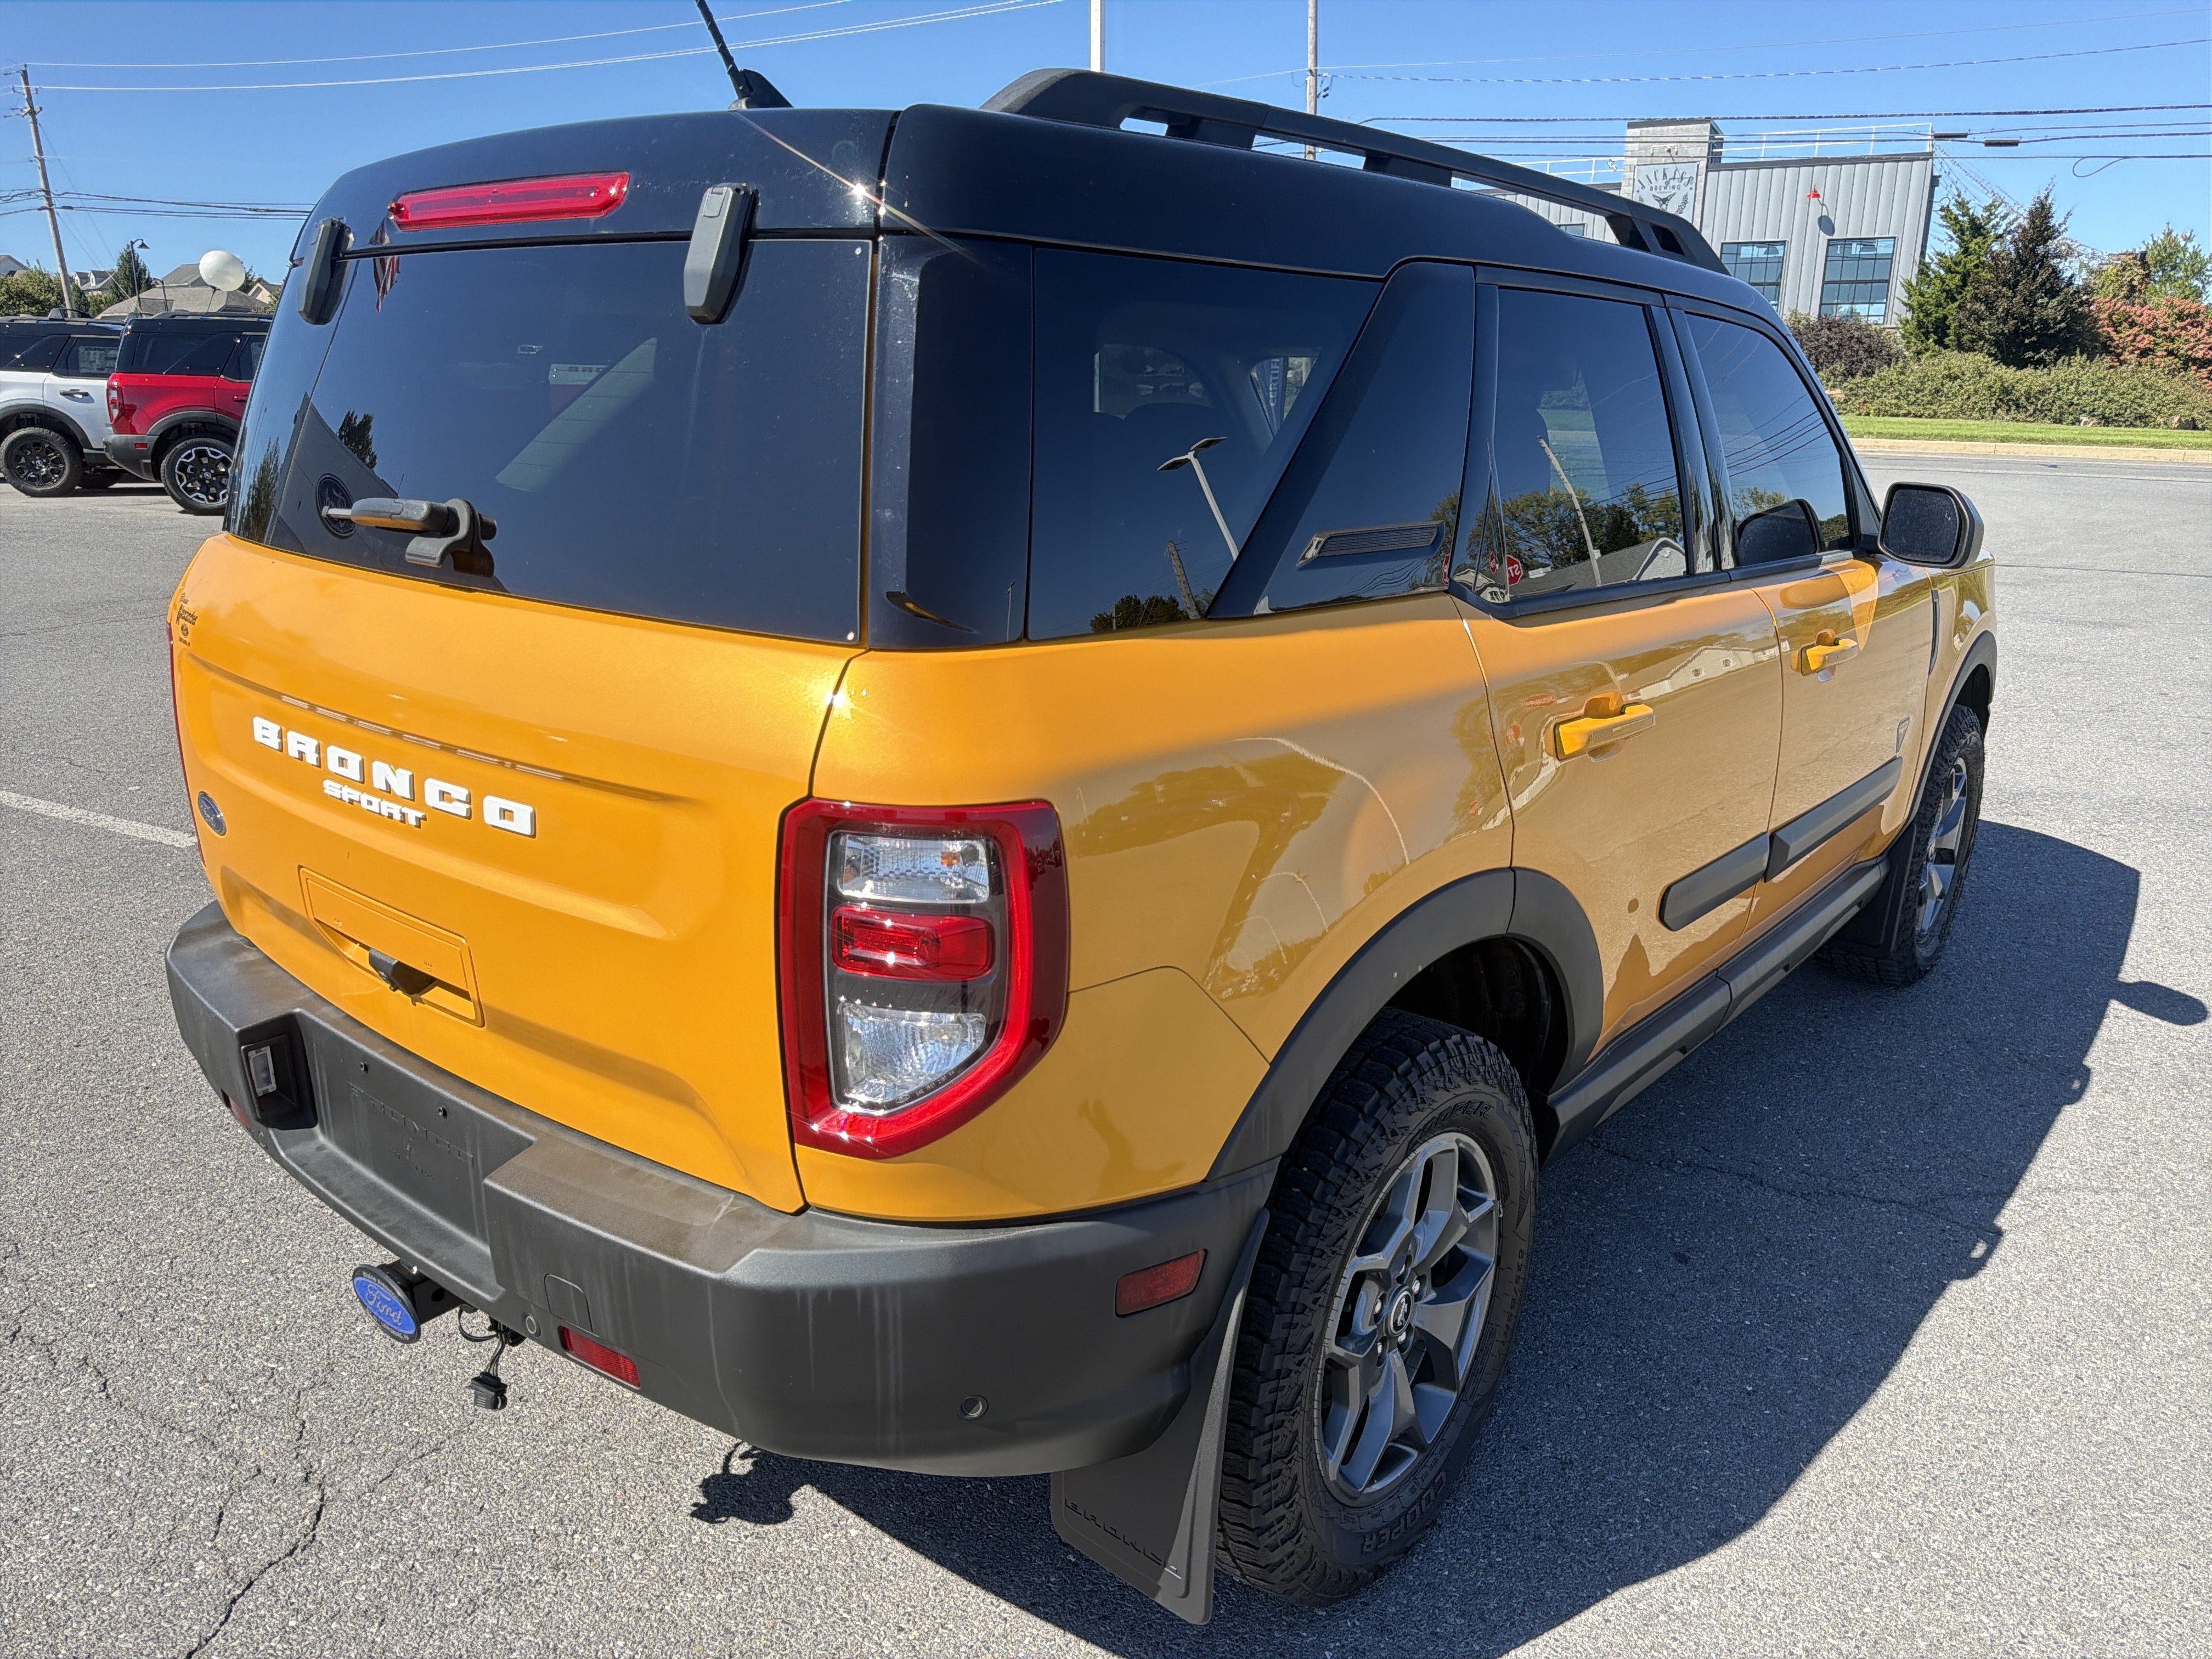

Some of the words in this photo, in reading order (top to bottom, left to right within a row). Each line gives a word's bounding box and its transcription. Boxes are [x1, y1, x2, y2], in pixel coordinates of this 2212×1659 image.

[253, 716, 536, 838] BRONCO
[323, 779, 427, 828] SPORT
[366, 1284, 403, 1326] Ford
[1361, 1468, 1448, 1554] COOPER
